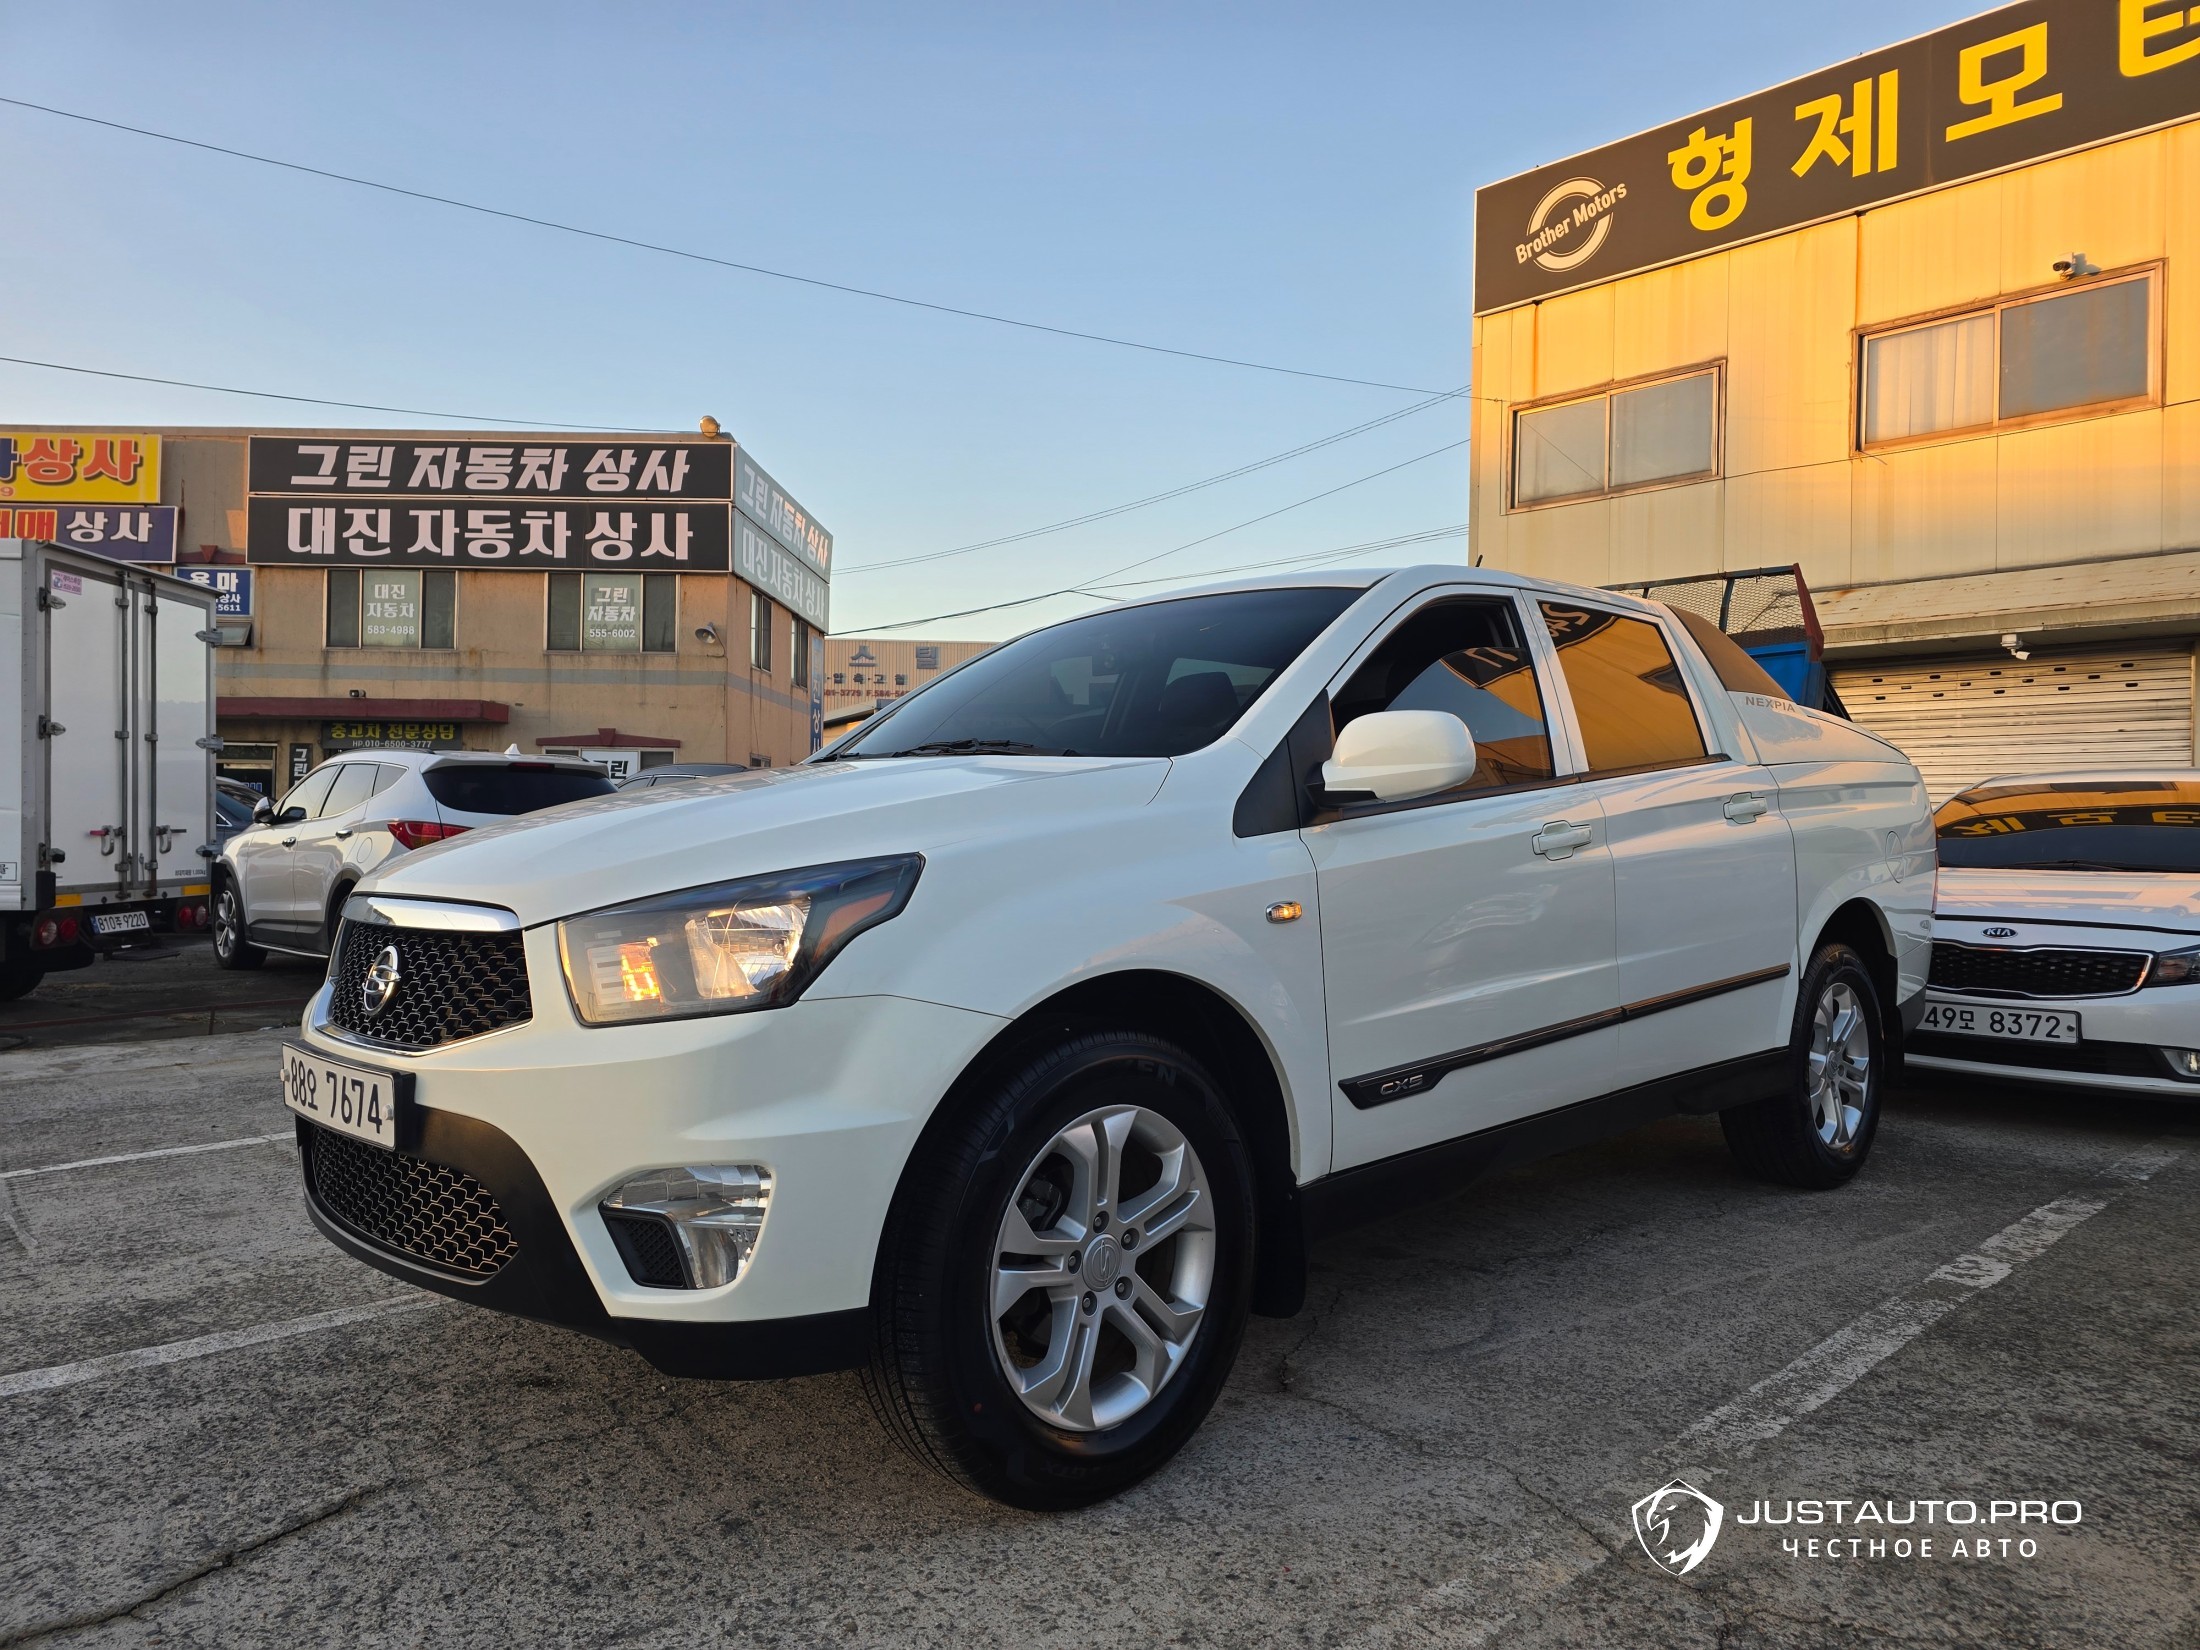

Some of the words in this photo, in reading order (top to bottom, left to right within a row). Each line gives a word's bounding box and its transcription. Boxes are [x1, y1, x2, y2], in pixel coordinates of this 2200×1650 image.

[1515, 217, 1571, 264] Brother
[1572, 183, 1627, 228] Motors
[290, 445, 396, 488] 그린
[407, 447, 569, 492] 자동차
[583, 449, 691, 492] 상사
[741, 462, 769, 520] 그린
[769, 488, 806, 551] 자동차
[806, 524, 829, 570] 상사
[66, 511, 153, 543] 상사
[287, 507, 391, 557] 대진
[407, 509, 571, 559] 자동차
[584, 511, 693, 561] 상사
[742, 526, 768, 582] 대진
[770, 548, 803, 608] 자동차
[805, 577, 825, 623] 상사
[215, 593, 241, 603] 상사
[374, 584, 406, 600] 대진
[596, 587, 629, 603] 그린
[366, 602, 415, 618] 자동차
[587, 605, 636, 622] 자동차
[367, 625, 415, 635] 583-4988
[590, 629, 636, 638] 555-6002
[1745, 696, 1796, 713] NEXPIA
[331, 723, 380, 739] 중고차
[387, 724, 454, 740] 전문상담
[293, 748, 308, 784] 그린
[1986, 928, 2011, 936] KIA
[1924, 1006, 1975, 1031] 49모
[1989, 1011, 2061, 1039] 8372
[291, 1056, 319, 1111] 88오
[325, 1070, 383, 1134] 7674
